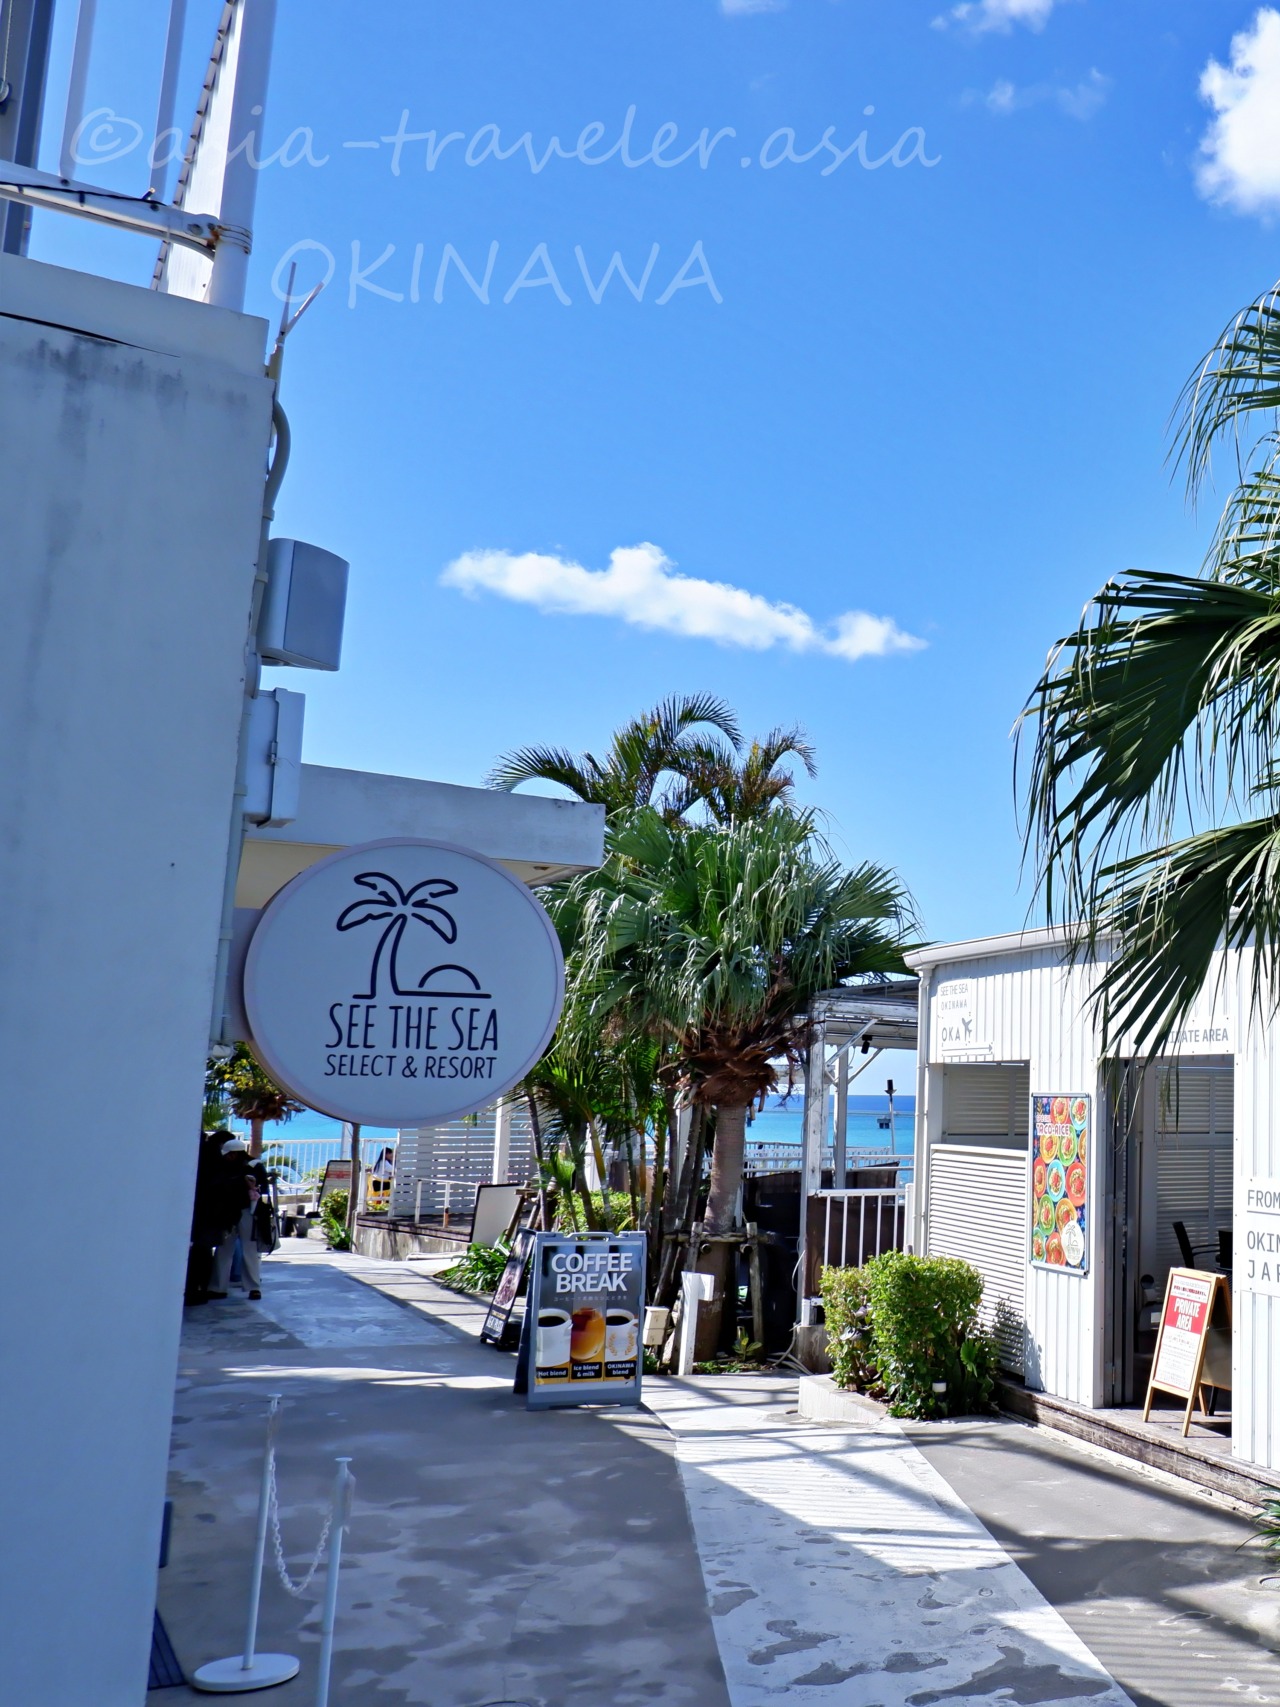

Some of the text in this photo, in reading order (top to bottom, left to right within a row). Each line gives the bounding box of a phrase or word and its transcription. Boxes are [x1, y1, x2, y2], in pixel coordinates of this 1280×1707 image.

[959, 983, 969, 994] SEA
[941, 999, 968, 1011] OKINAWA
[325, 1002, 498, 1051] SEE THE SEA
[942, 1026, 961, 1042] OKA
[1202, 1027, 1229, 1042] AREA
[324, 1053, 497, 1079] SELECT & RESORT
[1247, 1189, 1280, 1209] FROM
[551, 1252, 633, 1273] COFFEE
[556, 1272, 628, 1293] BREAK
[1174, 1297, 1201, 1318] PRIVATE
[1175, 1313, 1193, 1332] AREA
[550, 1369, 567, 1377] blend
[583, 1363, 600, 1371] blend
